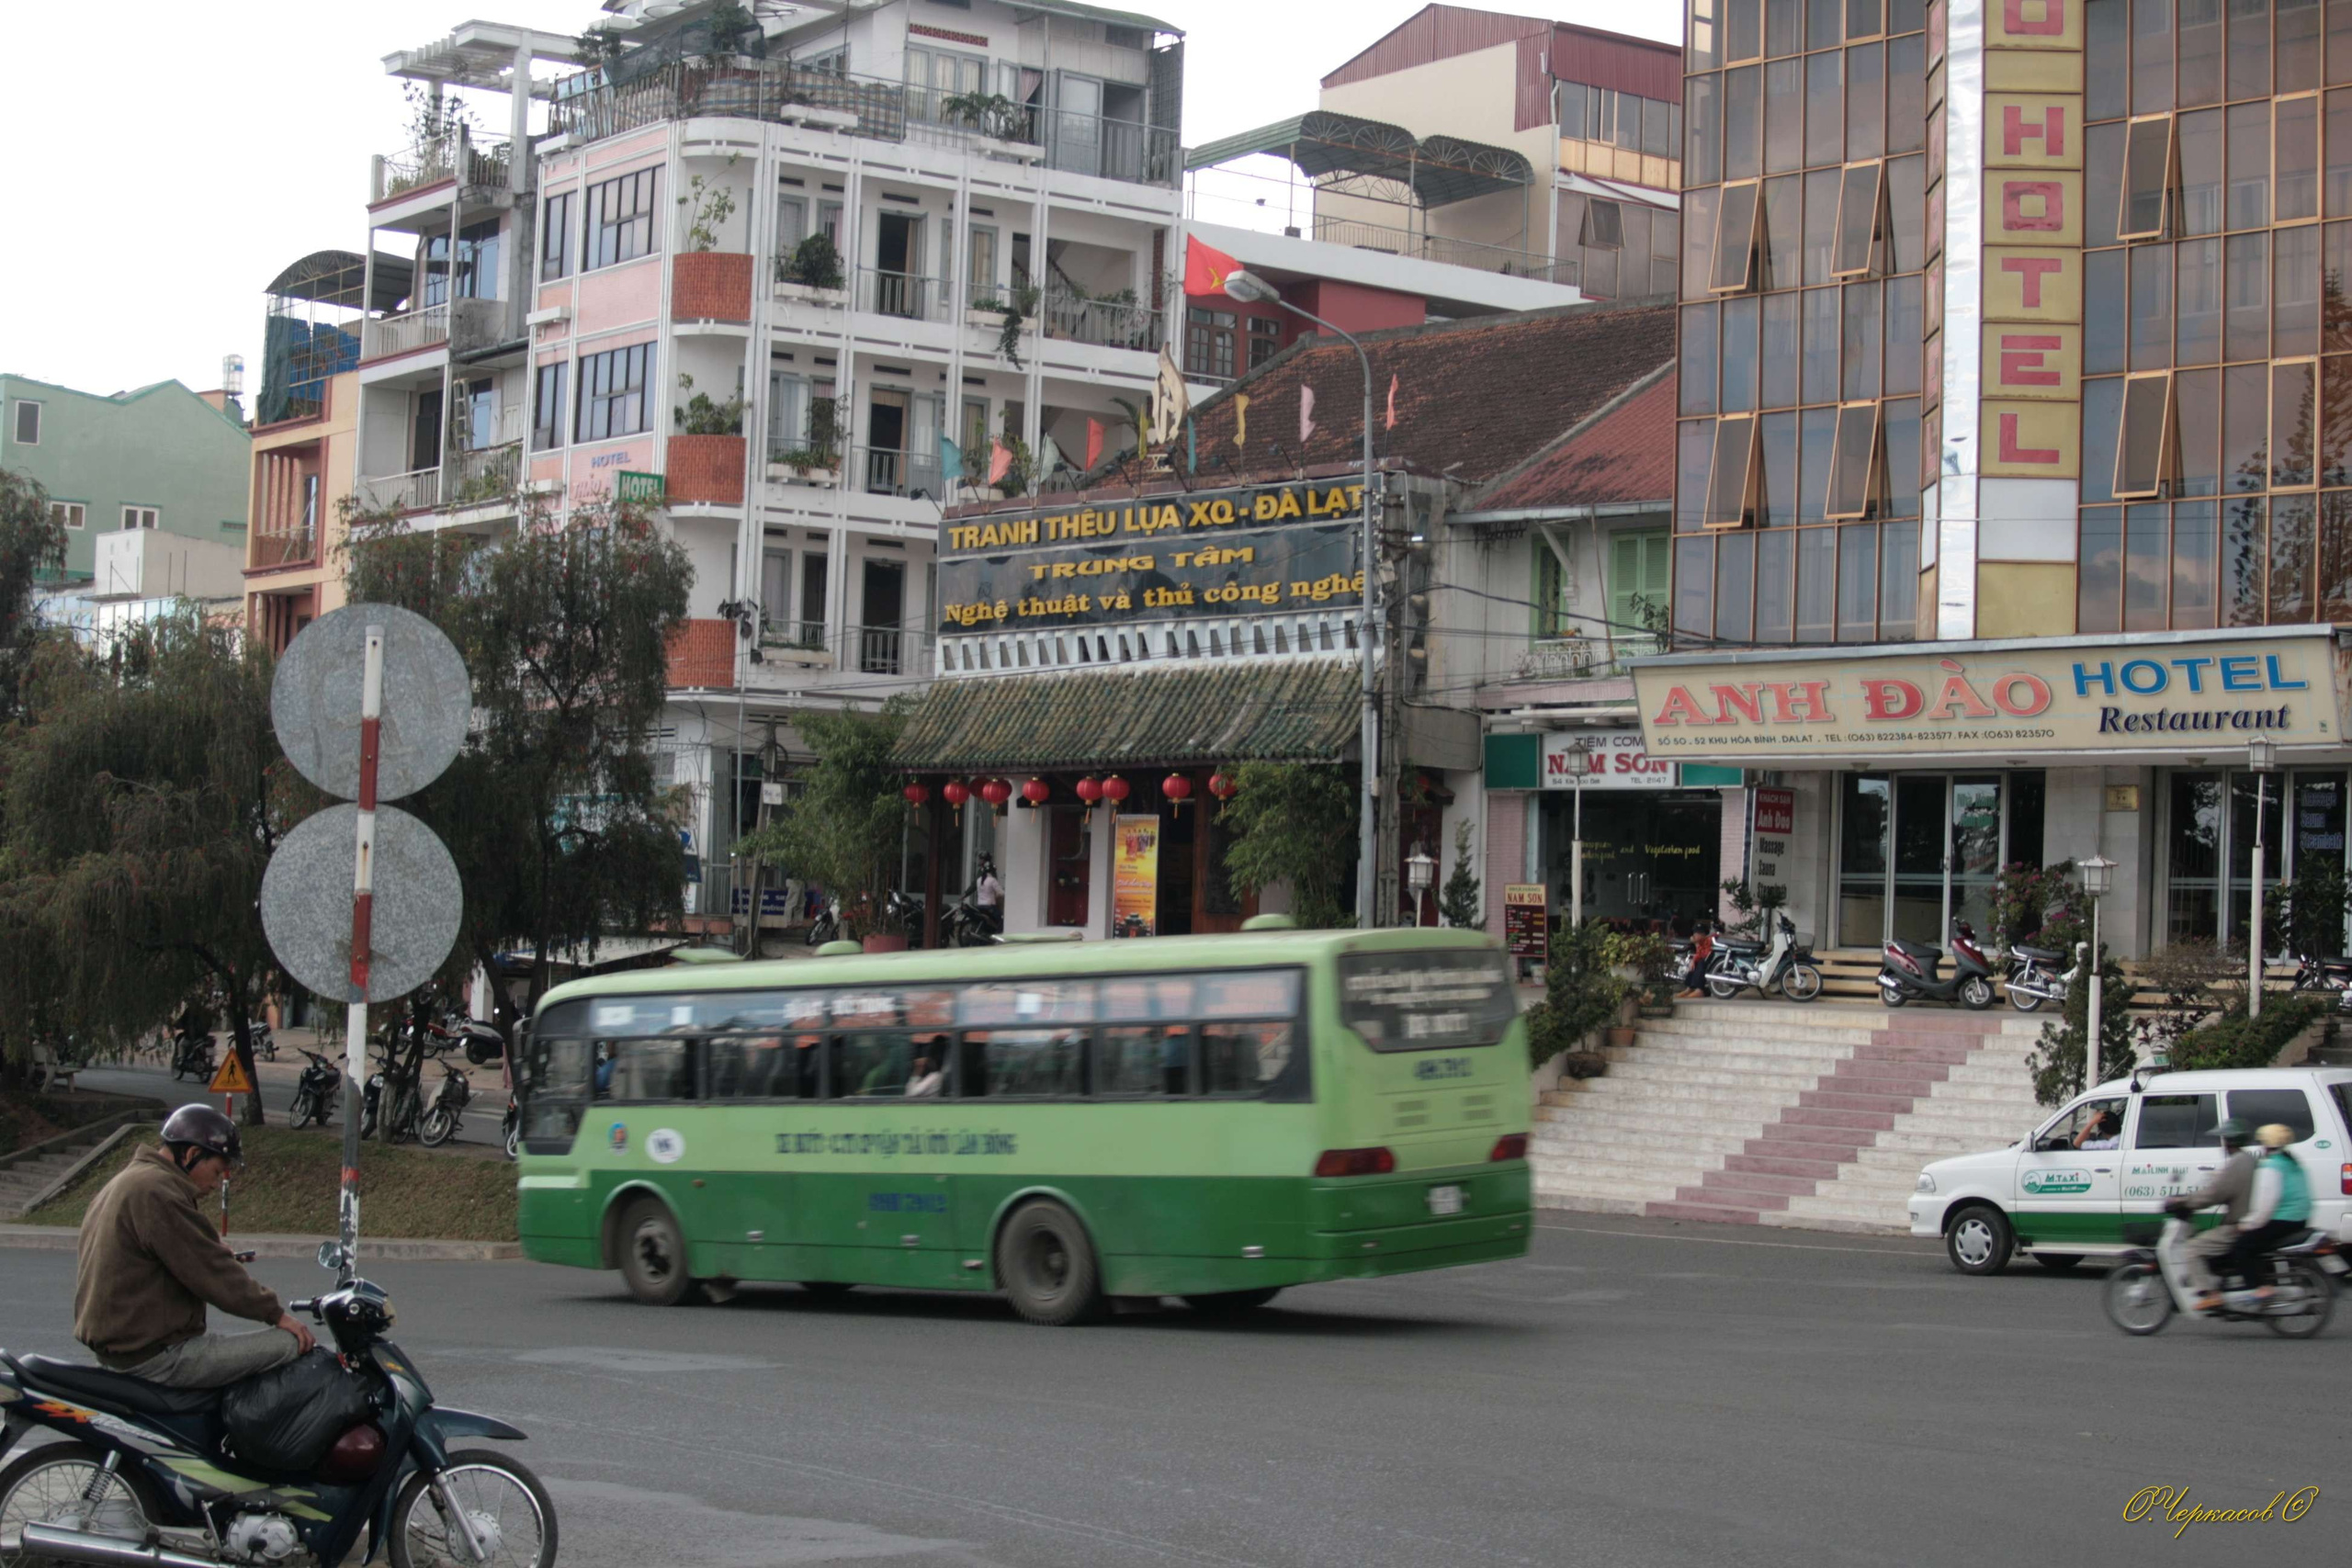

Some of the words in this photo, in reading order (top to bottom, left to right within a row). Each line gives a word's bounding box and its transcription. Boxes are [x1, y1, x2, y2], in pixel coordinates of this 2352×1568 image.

[1999, 106, 2064, 464] HOTEL
[591, 451, 631, 468] HOTEL
[947, 520, 1039, 549] TRANH
[1044, 508, 1118, 540] THÊU
[1125, 504, 1182, 536] LỤA
[1306, 484, 1365, 519] LẠT
[1028, 555, 1156, 580] TRUNG
[1169, 545, 1255, 568] TÂM
[944, 599, 1010, 626] Nghệ
[1017, 593, 1091, 618] thuật
[1098, 588, 1132, 610] và
[1143, 581, 1195, 608] thủ
[1204, 580, 1282, 605] công
[1290, 570, 1365, 601] nghệ
[1653, 680, 1836, 726] ANH
[1860, 659, 2053, 721] ĐÀO
[2072, 654, 2309, 697] HOTEL
[2098, 704, 2290, 734] Restaurant
[1694, 737, 1706, 745] 52
[1709, 736, 1727, 745] KHU
[2015, 728, 2055, 739] 823570
[1547, 754, 1606, 773] NM
[1758, 809, 1773, 829] Anh
[2300, 809, 2325, 828] Sauna
[1759, 837, 1784, 857] Massage
[2300, 831, 2344, 850] Steambath
[1758, 860, 1776, 876] Sauna
[1507, 893, 1524, 904] NAM
[2124, 1186, 2154, 1198] (063)
